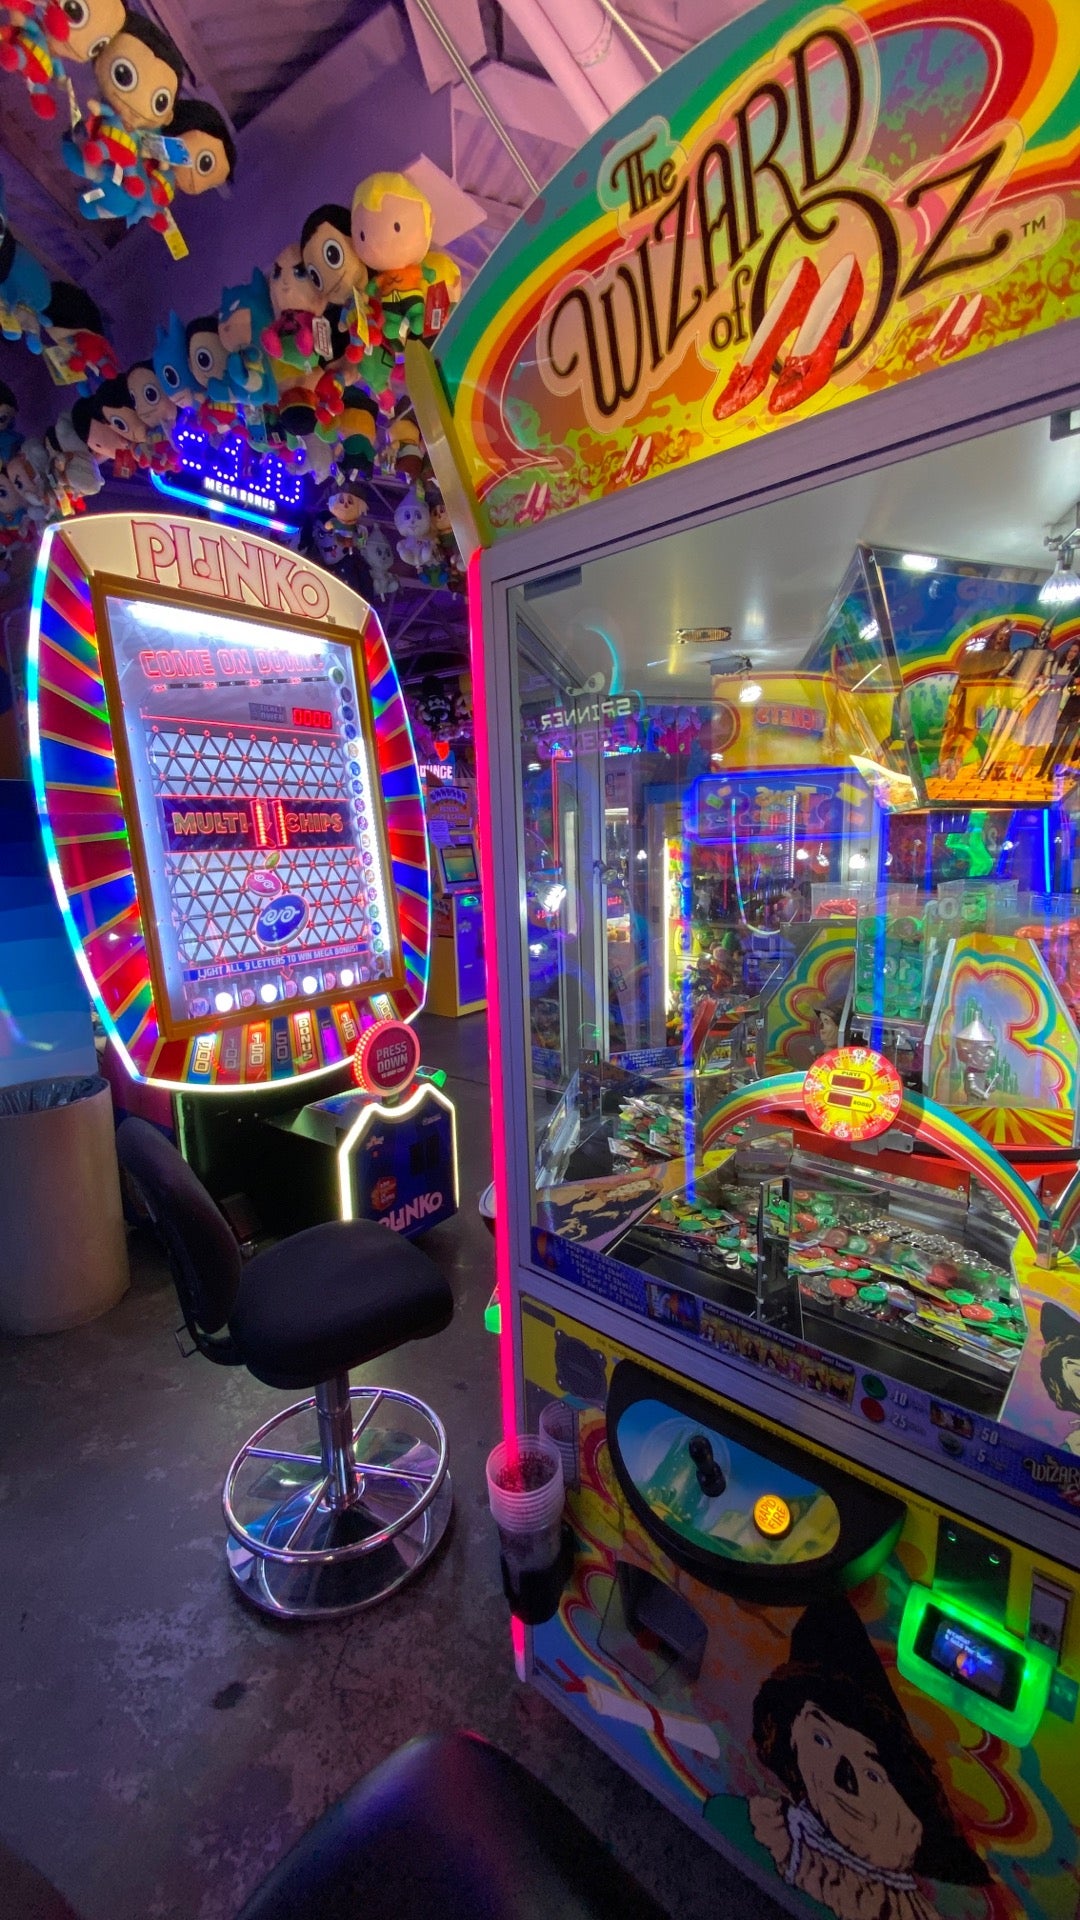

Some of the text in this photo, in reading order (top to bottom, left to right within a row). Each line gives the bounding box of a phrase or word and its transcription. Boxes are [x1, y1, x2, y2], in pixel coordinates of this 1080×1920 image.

[611, 135, 677, 216] The
[548, 27, 865, 416] WIZARD
[710, 270, 750, 351] of
[1021, 216, 1046, 236] TM
[205, 477, 276, 512] MEGA BONUS
[131, 519, 329, 618] PLINKO
[139, 650, 216, 678] COME
[217, 649, 253, 675] ON
[171, 812, 344, 835] MULTI CHIPS
[226, 963, 242, 974] ALL
[245, 962, 250, 971] 9
[252, 958, 286, 969] LETTERS
[288, 955, 296, 963] TO
[299, 952, 312, 962] WIN
[314, 949, 334, 959] MEGA
[298, 1017, 313, 1060] BONUS
[341, 1011, 356, 1043] 150
[249, 1031, 266, 1066] 150
[276, 1031, 288, 1062] 50
[376, 1041, 407, 1061] PRESS
[377, 1053, 408, 1073] DOWN
[894, 1390, 908, 1406] 10
[892, 1413, 906, 1428] 25
[981, 1428, 998, 1445] 50
[977, 1450, 985, 1463] 5
[1023, 1458, 1080, 1483] WIZAR
[759, 1499, 776, 1523] RAPID
[768, 1506, 786, 1529] FIRE
